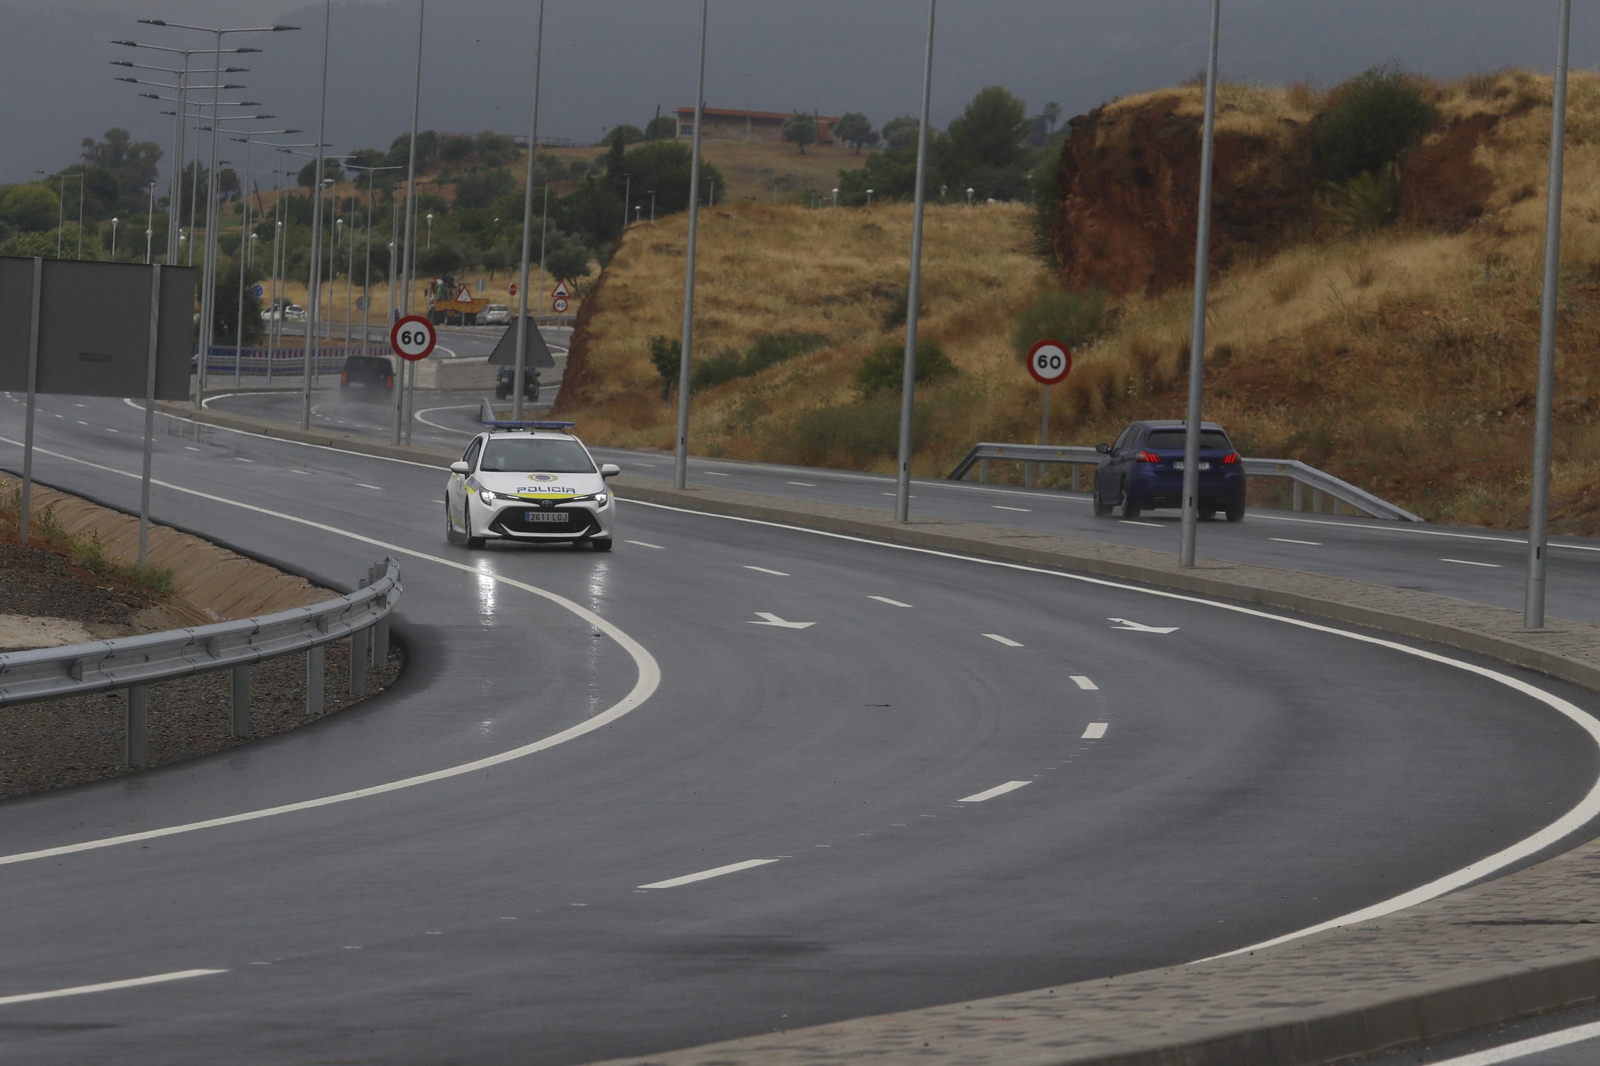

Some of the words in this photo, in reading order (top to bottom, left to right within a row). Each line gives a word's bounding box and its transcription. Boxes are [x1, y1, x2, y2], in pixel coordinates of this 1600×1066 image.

[401, 331, 425, 345] 60
[1038, 354, 1061, 369] 60
[530, 513, 550, 521] 2611
[552, 513, 567, 521] LGJ
